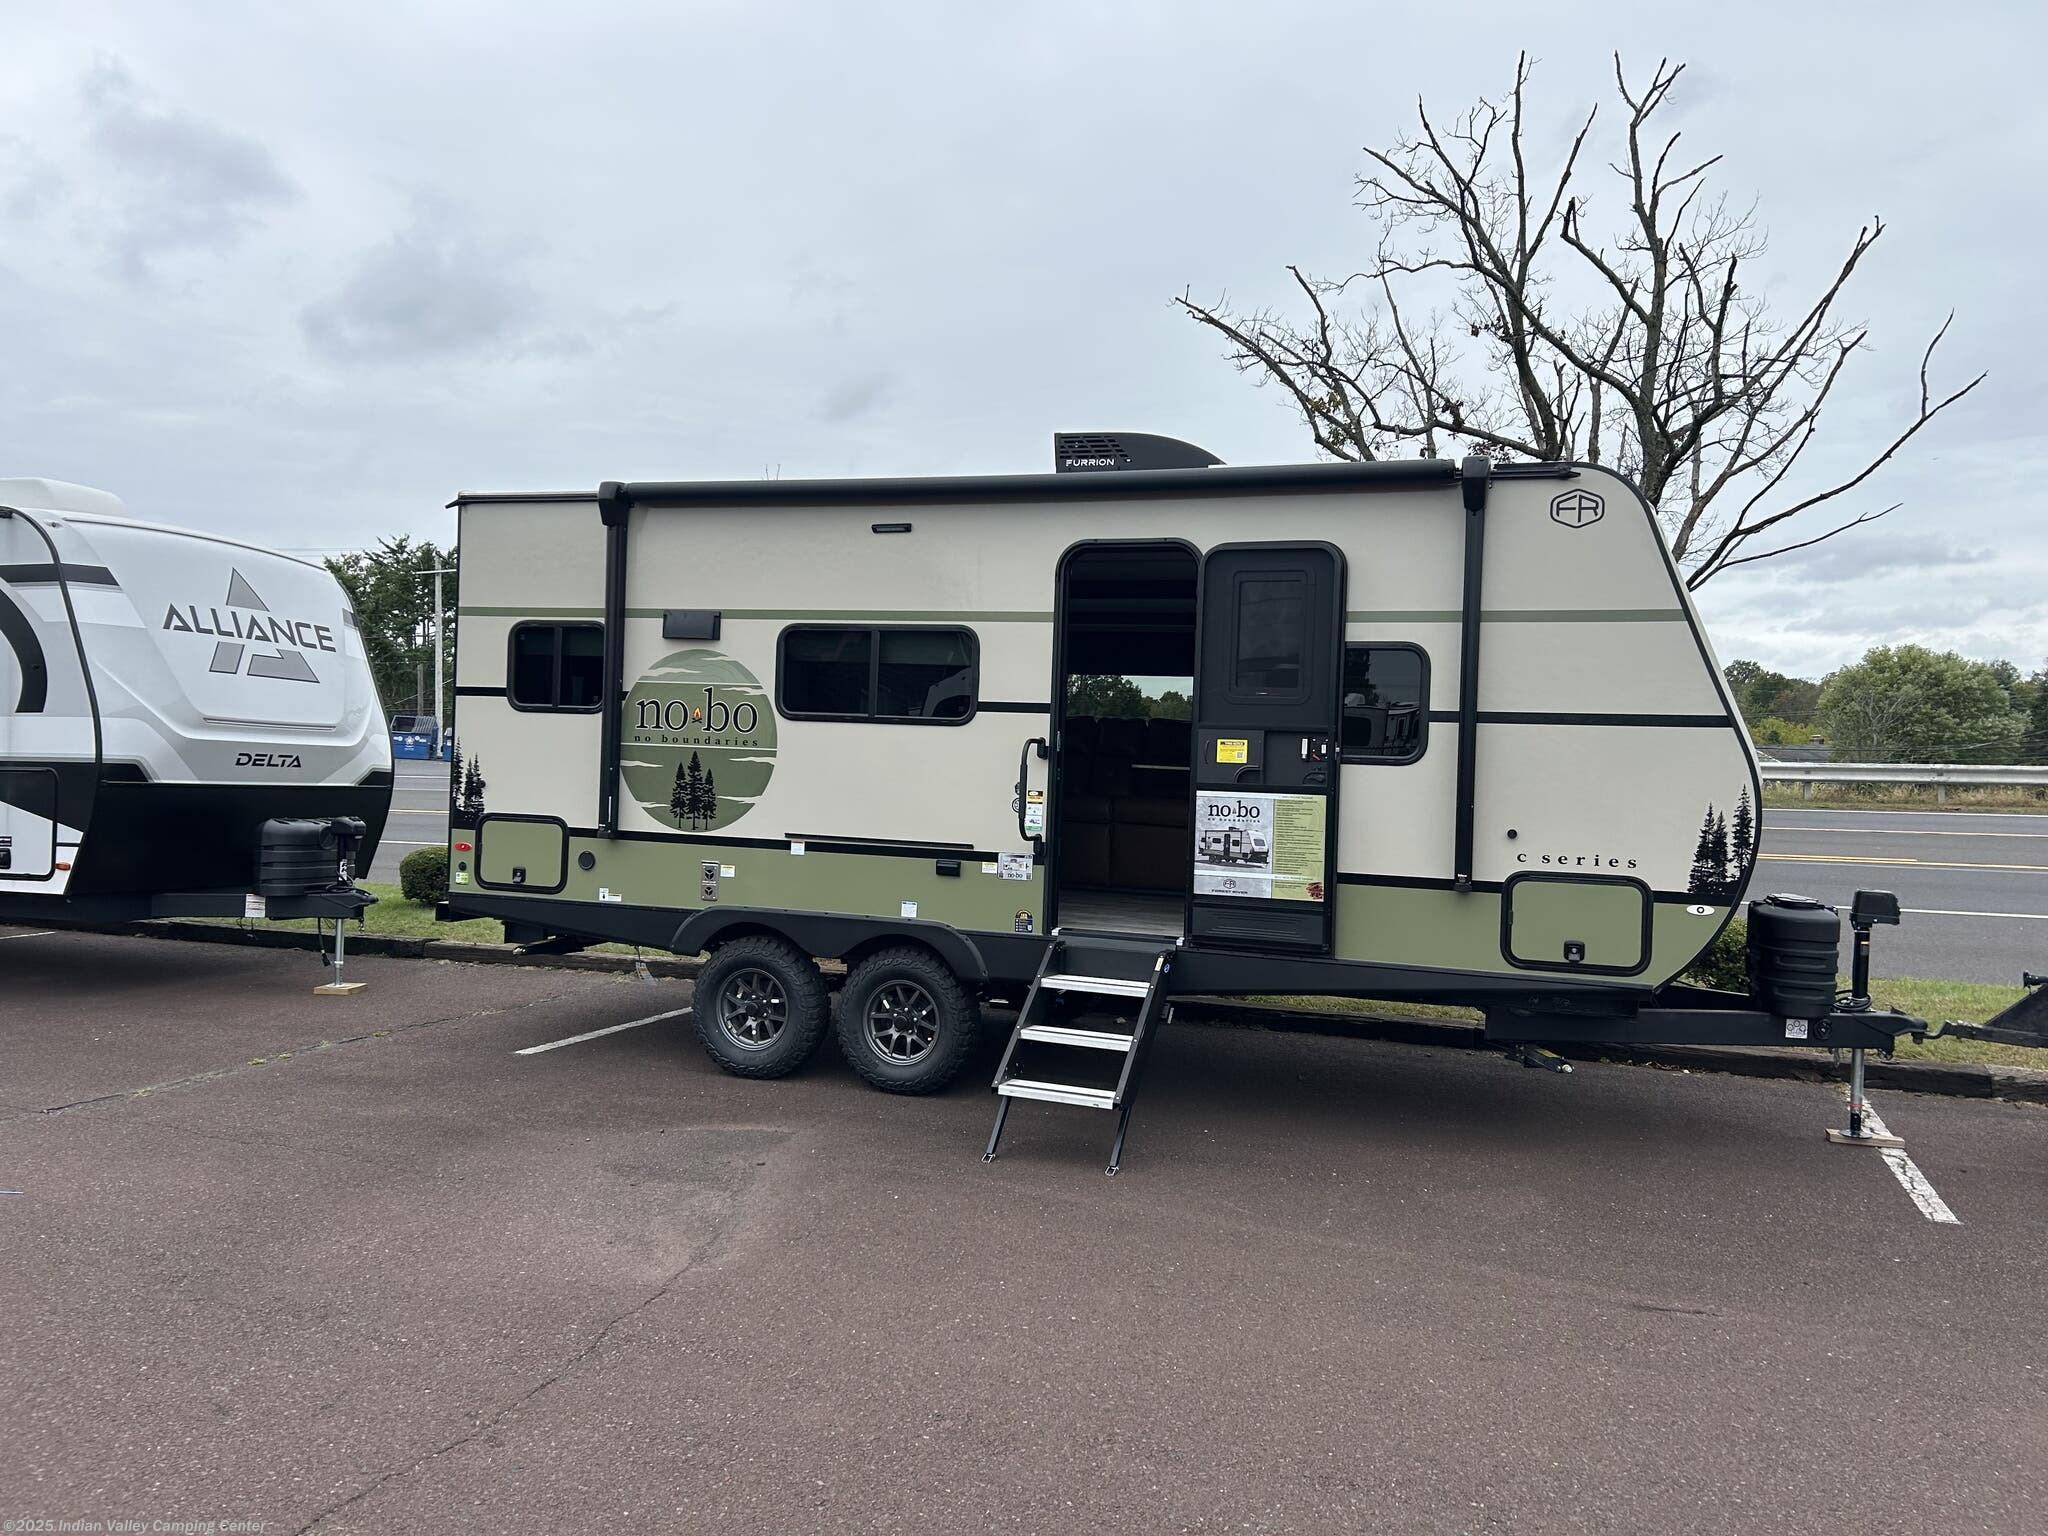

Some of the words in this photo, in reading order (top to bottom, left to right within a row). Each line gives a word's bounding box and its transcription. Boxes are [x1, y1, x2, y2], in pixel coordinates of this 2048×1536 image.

[1065, 458, 1115, 467] FURRION
[163, 603, 337, 653] ALLIANCE
[661, 735, 758, 746] boundaries
[235, 752, 302, 768] DELTA
[1516, 853, 1527, 863] c
[1541, 853, 1637, 869] series
